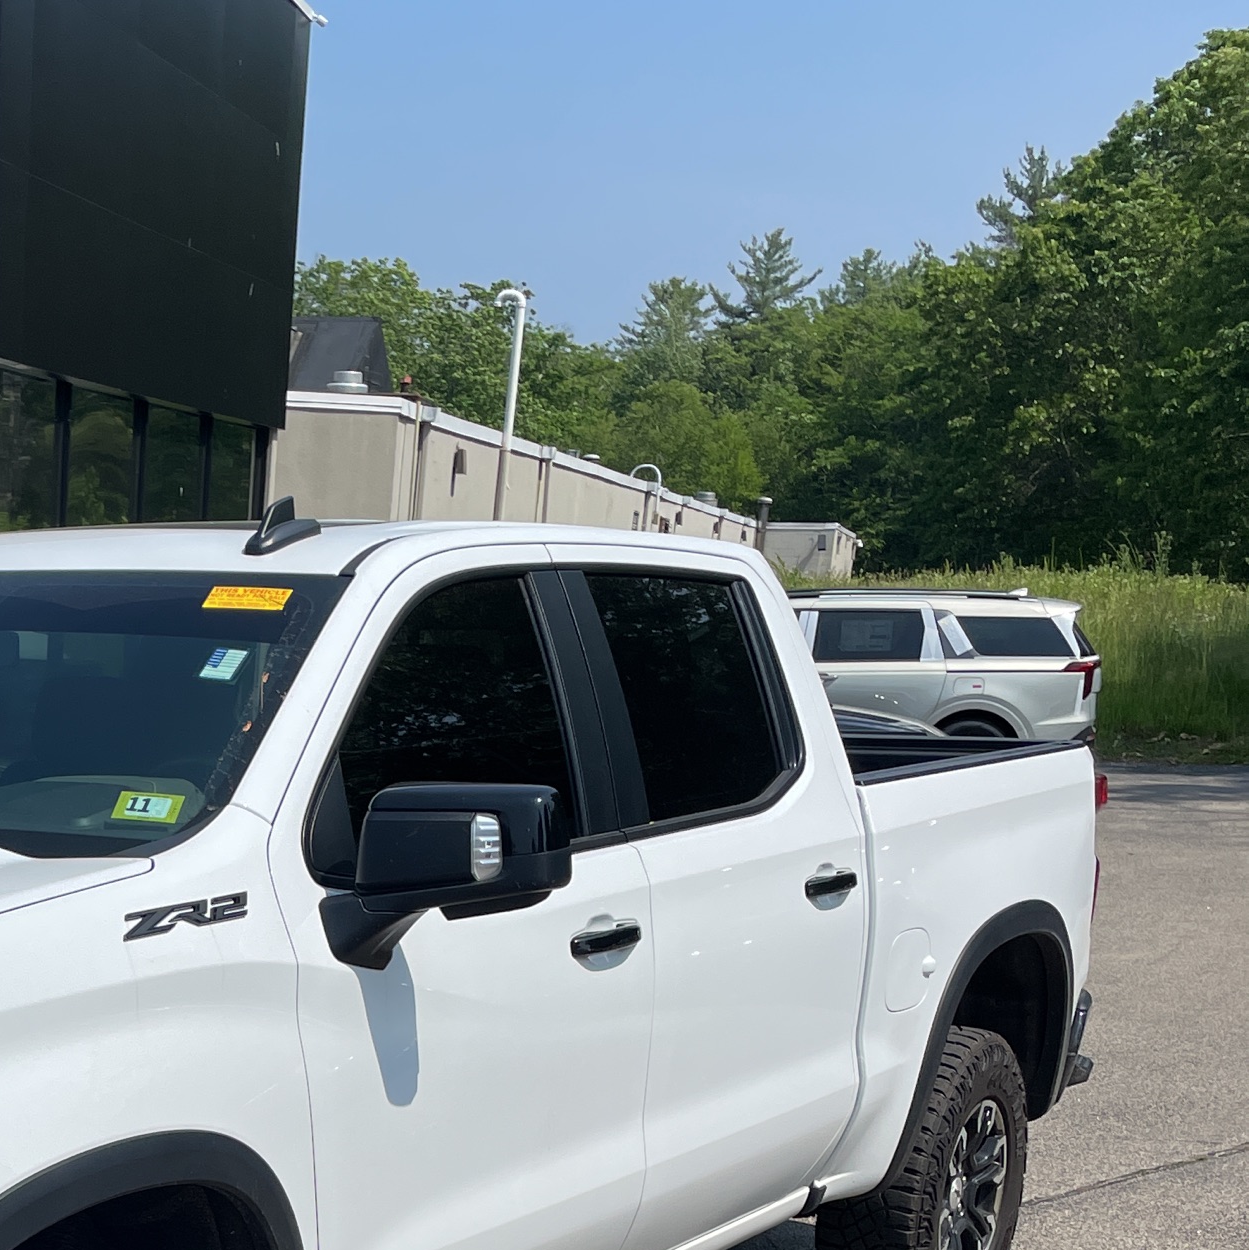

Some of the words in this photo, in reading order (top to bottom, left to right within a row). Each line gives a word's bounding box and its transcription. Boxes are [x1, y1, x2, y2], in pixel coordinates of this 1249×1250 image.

[243, 588, 289, 596] VEHICLE
[126, 796, 151, 813] 11
[123, 891, 248, 942] ZR2
